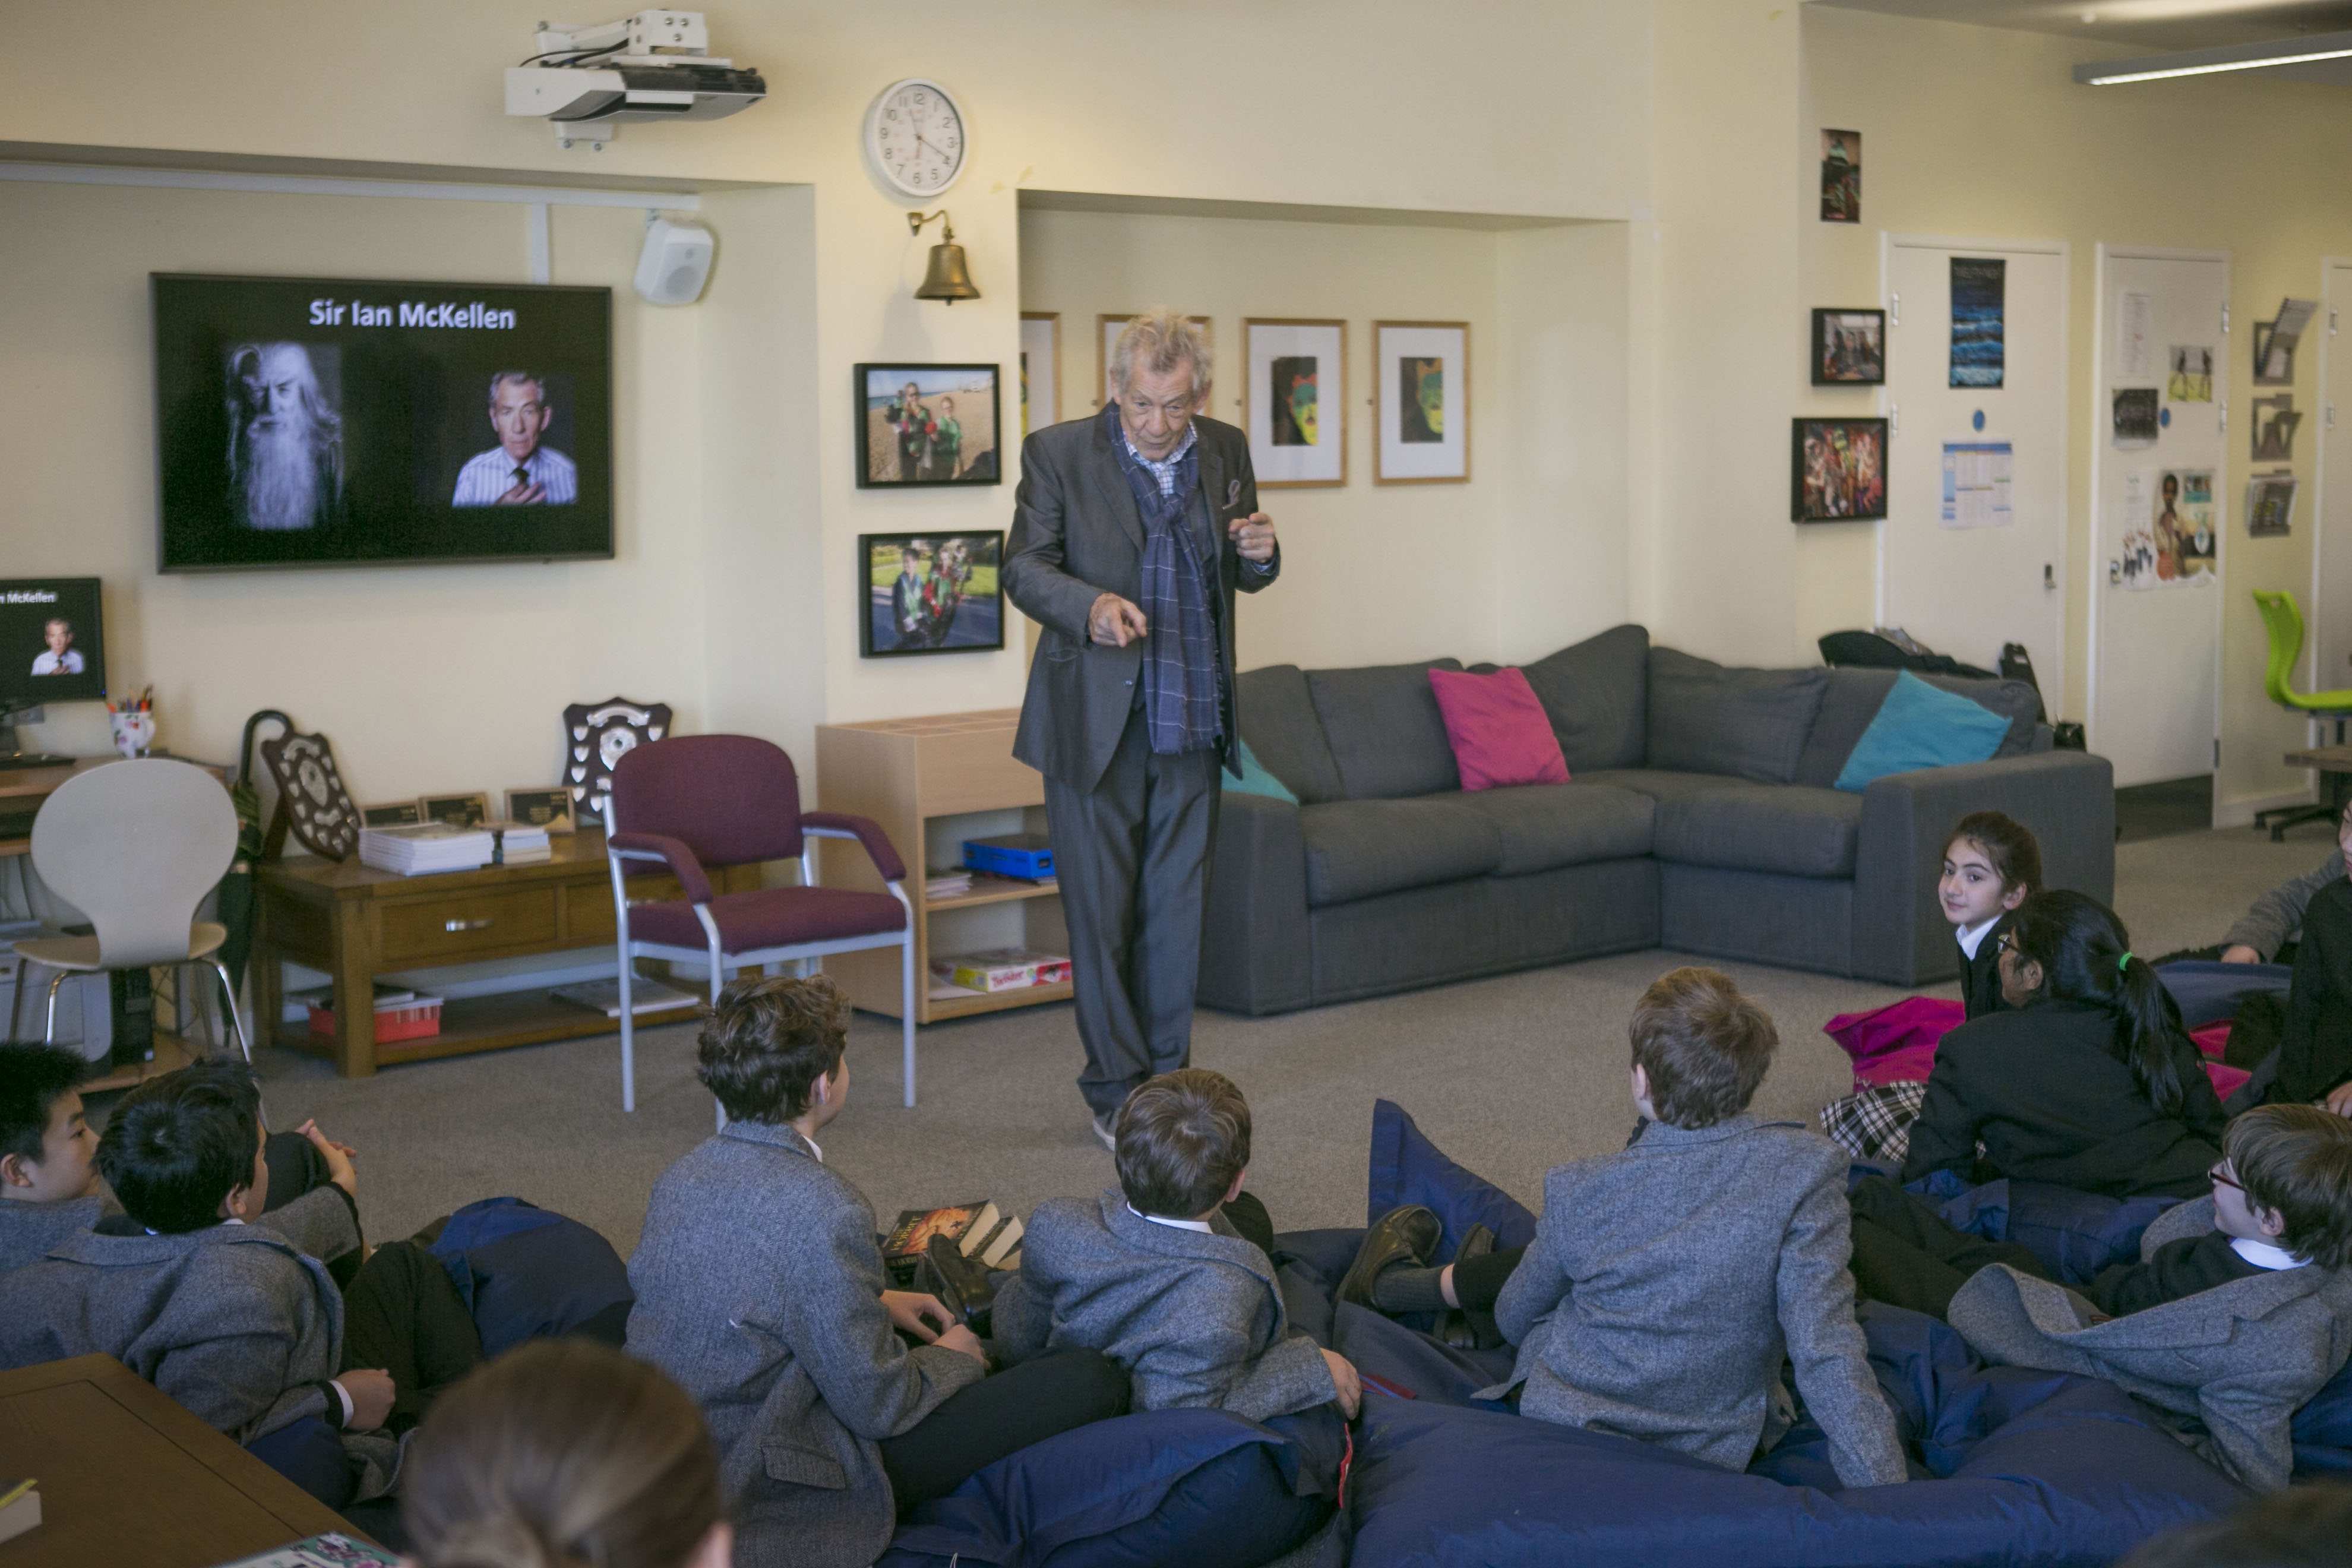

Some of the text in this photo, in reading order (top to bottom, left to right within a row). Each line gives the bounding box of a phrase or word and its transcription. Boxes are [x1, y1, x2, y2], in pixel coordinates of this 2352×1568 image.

[898, 96, 908, 107] 11
[913, 93, 925, 105] 12
[883, 109, 897, 121] 10
[943, 117, 951, 128] 2
[880, 127, 888, 139] 9
[947, 137, 955, 148] 3
[884, 148, 892, 160] 8
[896, 164, 905, 176] 7
[931, 168, 938, 181] 5
[913, 172, 921, 184] 6
[309, 299, 516, 330] Sir Ian McKellen
[7, 591, 56, 603] McKellen
